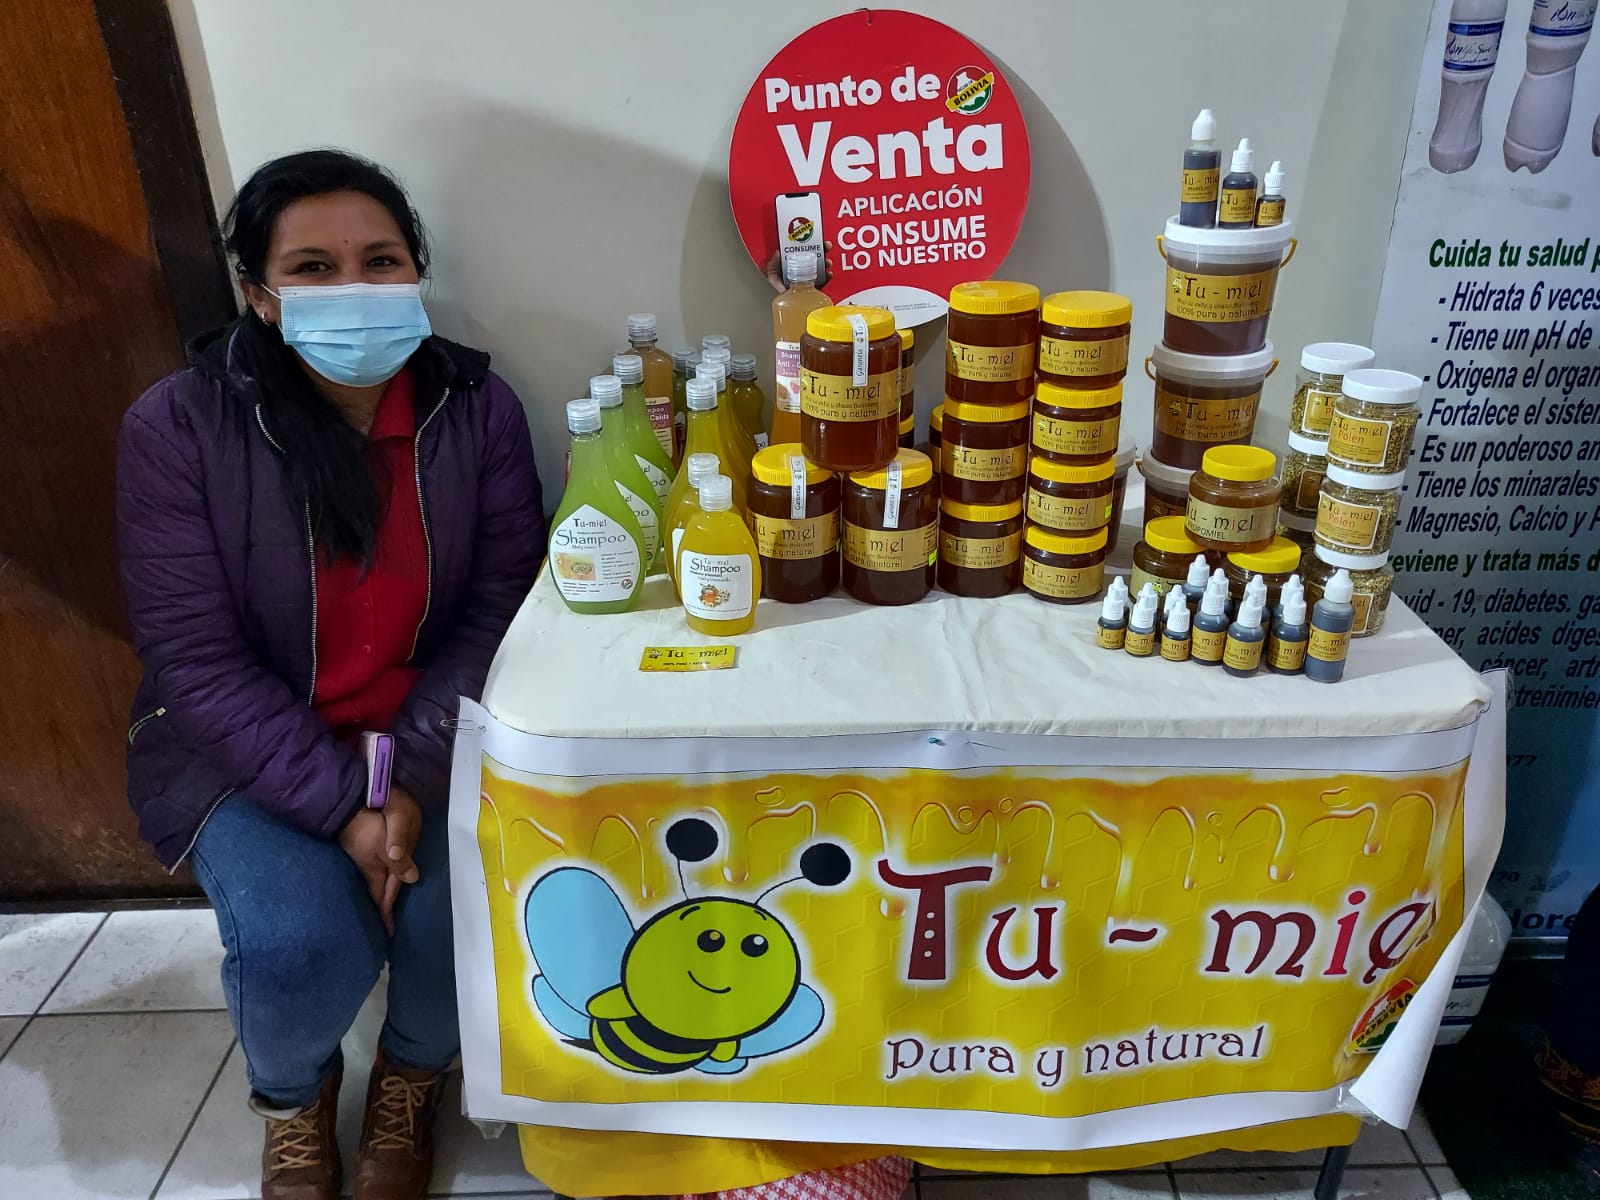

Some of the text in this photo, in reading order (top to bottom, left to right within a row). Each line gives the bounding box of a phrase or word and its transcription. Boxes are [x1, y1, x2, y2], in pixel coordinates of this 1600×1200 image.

[765, 66, 941, 113] Punto de
[953, 79, 989, 106] BOLIVIA
[776, 116, 1003, 187] Venta
[837, 184, 982, 218] APLICACIÓN
[837, 215, 986, 250] CONSUME
[784, 245, 821, 253] CONSUME
[841, 241, 986, 271] LO NUESTRO
[1429, 238, 1490, 268] Cuida
[1499, 239, 1521, 267] tu
[1526, 238, 1590, 267] salud
[1184, 275, 1263, 300] Tu miel
[1450, 281, 1525, 311] Hidrata
[1529, 281, 1545, 311] 6
[1547, 288, 1600, 311] veces
[1196, 310, 1217, 319] pura
[1047, 339, 1102, 360] Tu miel
[1445, 321, 1498, 351] Tiene
[1502, 328, 1530, 351] un
[1529, 320, 1567, 358] pH
[1566, 319, 1593, 350] de
[960, 345, 1014, 365] Tu miel
[809, 375, 880, 400] Tu miel
[1437, 360, 1515, 396] Oxigena
[1522, 359, 1544, 388] el
[1184, 400, 1255, 421] Tu miel
[1427, 397, 1519, 427] Fortalece
[1523, 396, 1546, 425] el
[1047, 419, 1102, 440] Tu miel
[1339, 431, 1364, 444] Polen
[962, 450, 1013, 466] Tu miel
[1419, 435, 1447, 463] Es
[1450, 442, 1477, 463] un
[1478, 434, 1573, 468] poderoso
[1415, 470, 1467, 498] Tiene
[1469, 471, 1501, 498] los
[1503, 469, 1599, 498] minarales
[1038, 496, 1088, 515] Tu miel
[1350, 510, 1374, 521] miel
[782, 523, 815, 541] miel
[1214, 514, 1254, 533] miel
[1328, 515, 1355, 528] Polen
[1405, 505, 1503, 539] Magnesio,
[1509, 504, 1568, 532] Calcio
[1568, 511, 1588, 539] y
[555, 529, 626, 548] Shampoo
[871, 537, 904, 554] miel
[981, 541, 1005, 555] miel
[690, 557, 741, 577] Shampoo
[1462, 554, 1478, 578] y
[1483, 548, 1531, 572] trata
[1536, 546, 1581, 571] más
[1056, 573, 1080, 584] miel
[1453, 588, 1477, 618] 19,
[1484, 587, 1571, 613] diabetes.
[1477, 620, 1542, 646] acides
[667, 650, 684, 658] Tu
[878, 859, 1058, 980] Tu
[1037, 1046, 1064, 1087] y
[1085, 1024, 1265, 1074] natural
